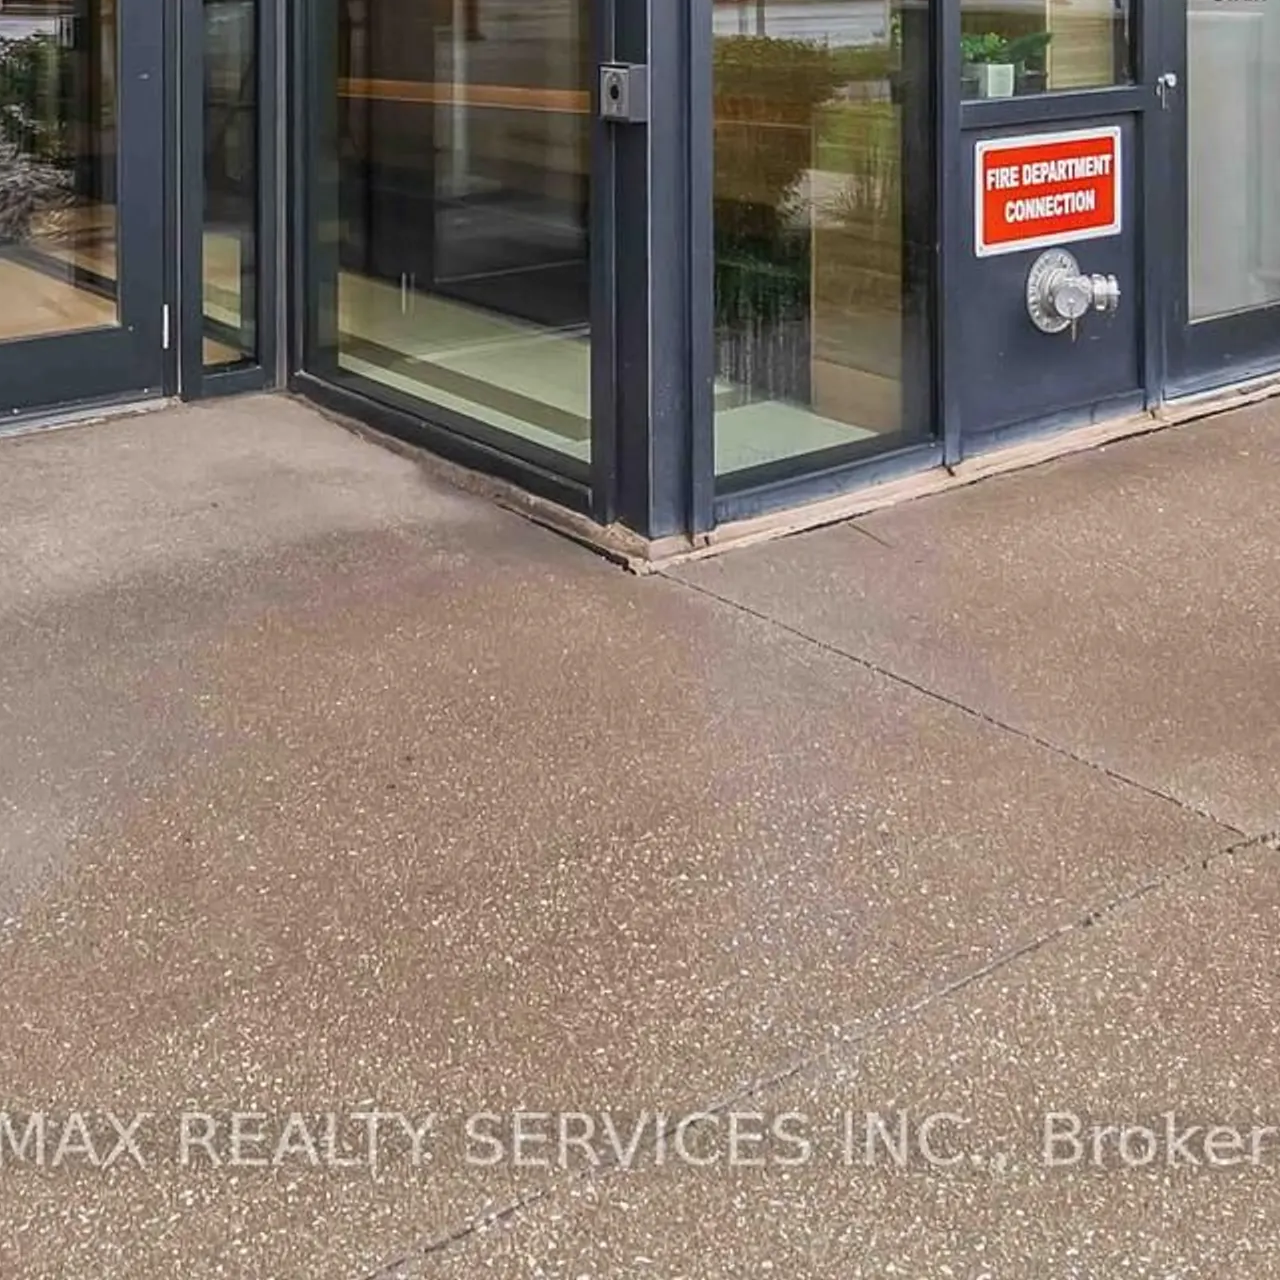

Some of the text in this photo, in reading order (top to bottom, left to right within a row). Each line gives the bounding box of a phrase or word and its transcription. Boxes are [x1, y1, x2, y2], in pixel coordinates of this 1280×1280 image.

[986, 153, 1113, 191] FIRE DEPARTMENT
[1005, 189, 1096, 223] CONNECTION
